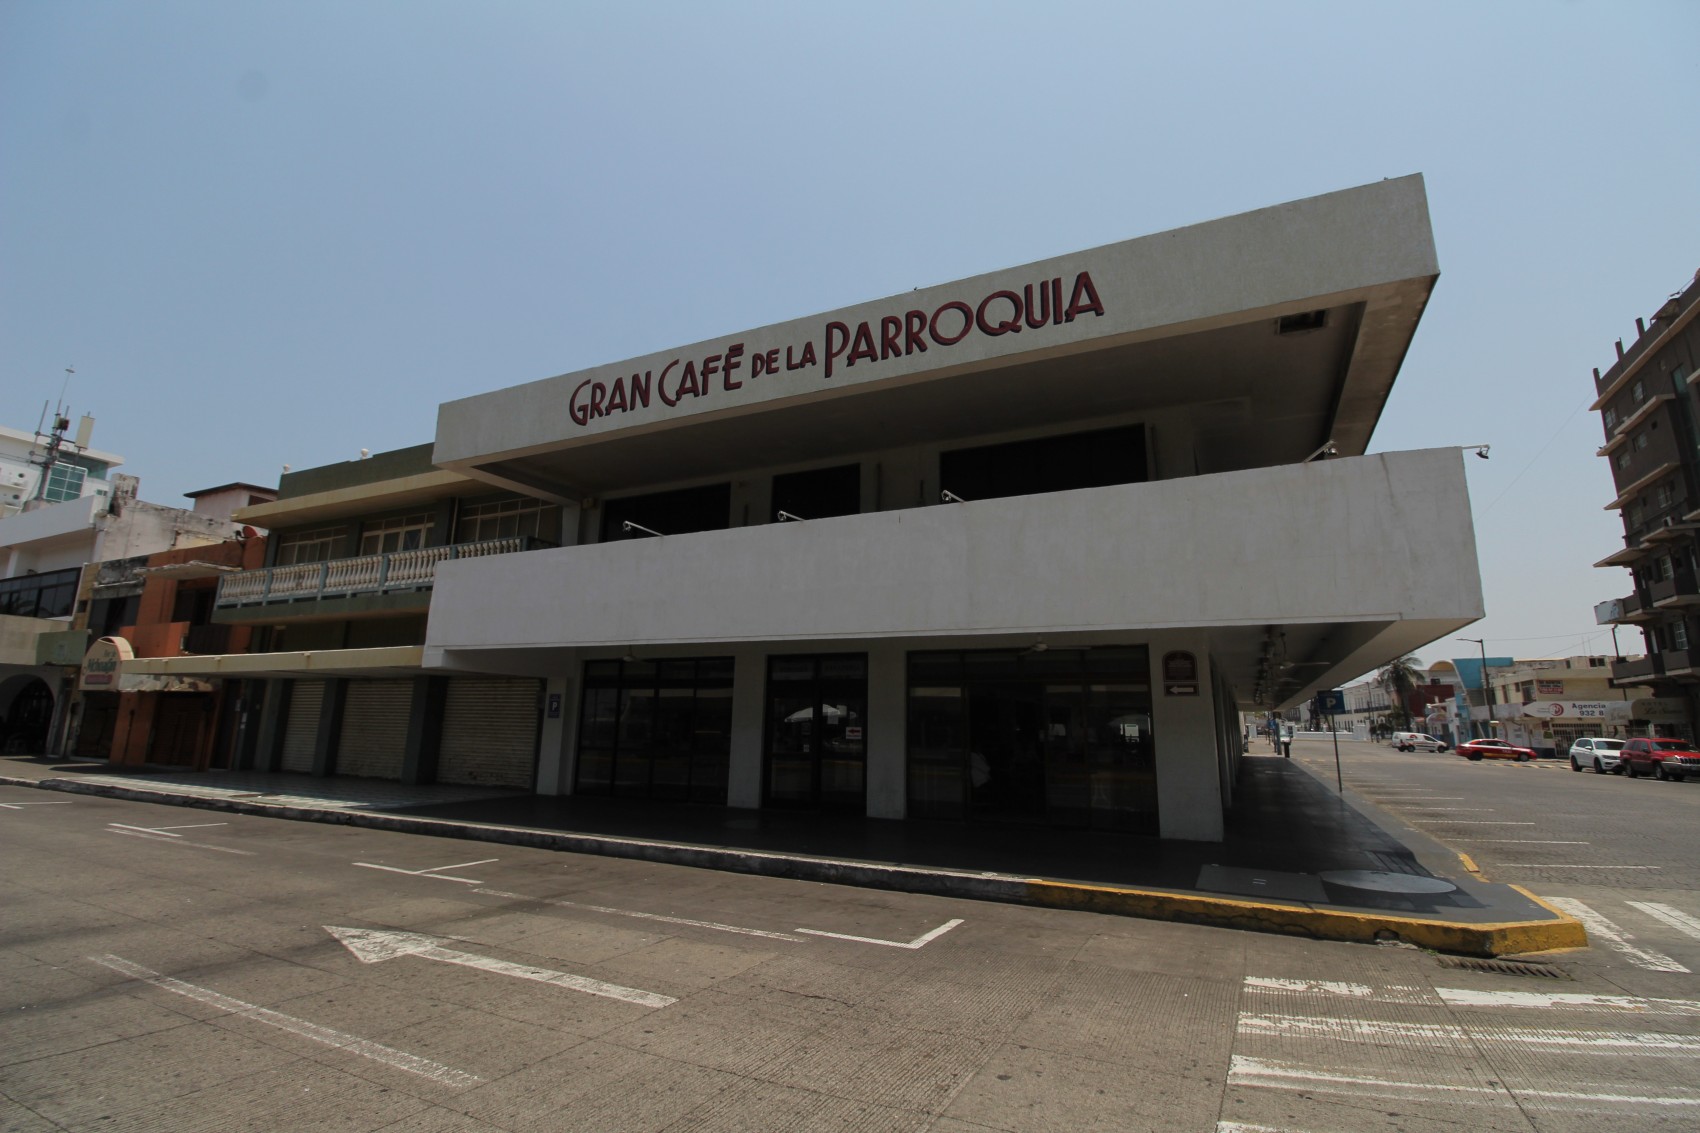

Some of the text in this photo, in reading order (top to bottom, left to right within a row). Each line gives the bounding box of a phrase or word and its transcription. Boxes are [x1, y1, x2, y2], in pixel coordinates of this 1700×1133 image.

[569, 271, 1105, 426] GRAN CAFÉ DE LA PARROQUIA
[552, 701, 558, 711] P
[1326, 697, 1336, 708] P
